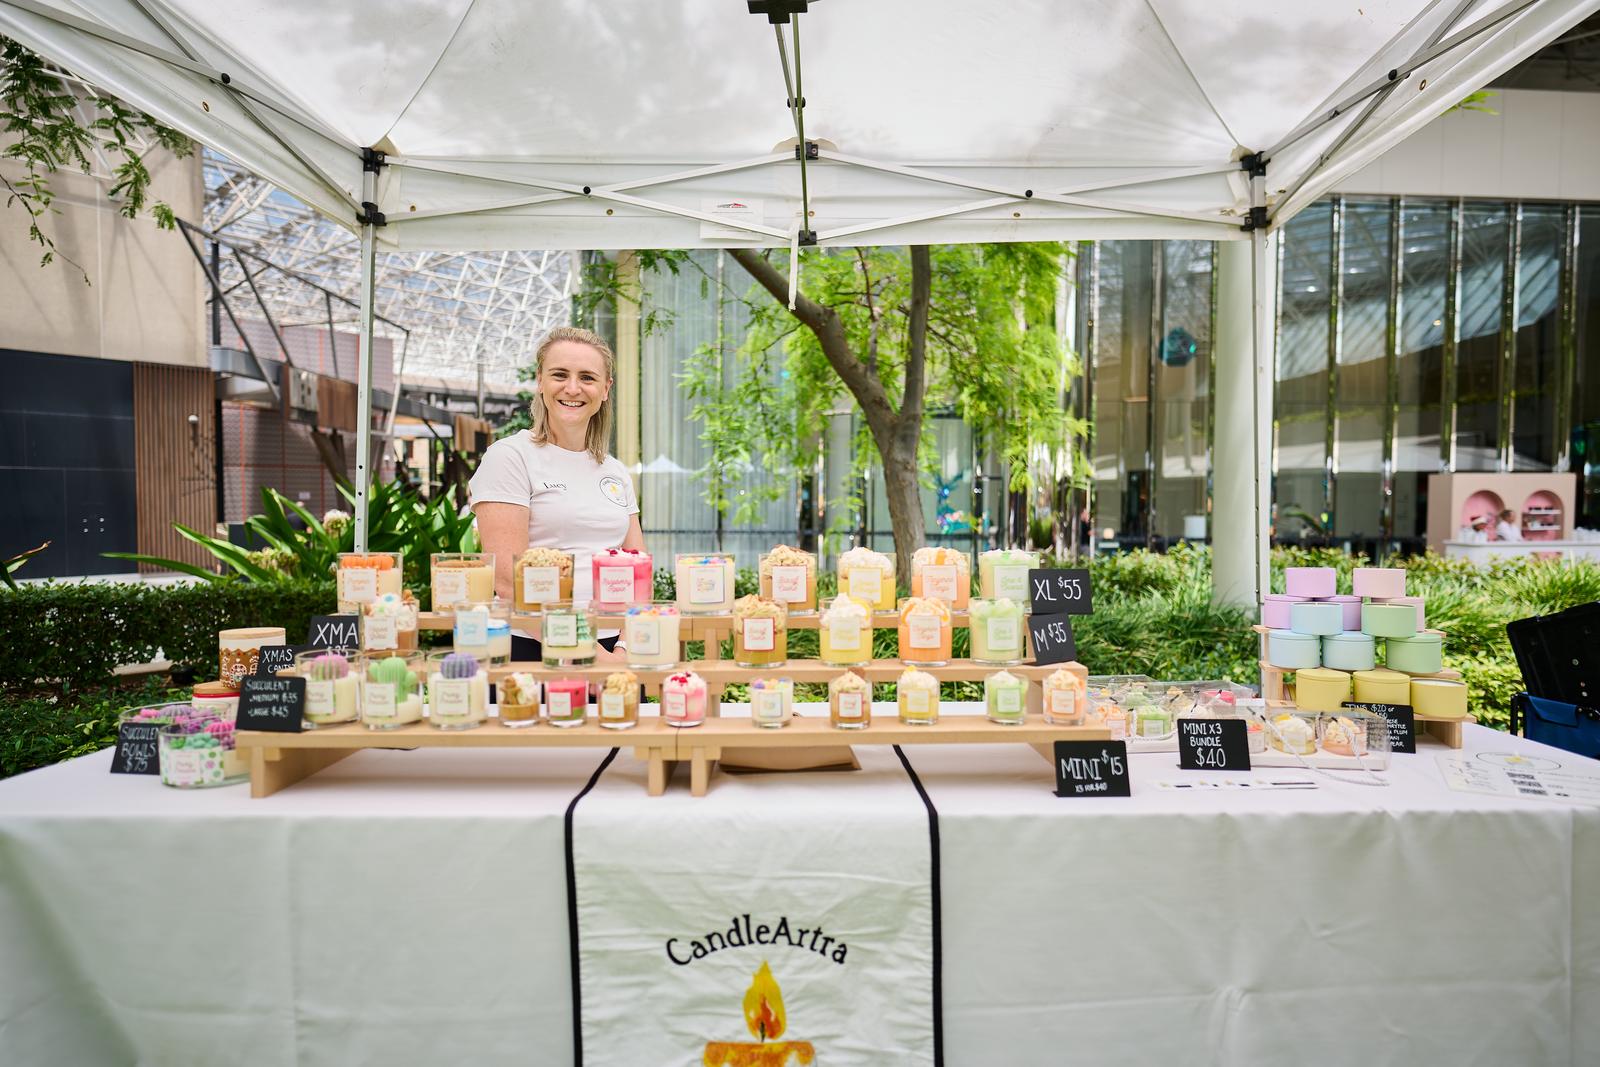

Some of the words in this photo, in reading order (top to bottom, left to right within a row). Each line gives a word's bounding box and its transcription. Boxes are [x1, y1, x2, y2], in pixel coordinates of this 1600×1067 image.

[543, 482, 567, 491] Lucy
[1034, 579, 1057, 601] XL
[1058, 576, 1082, 600] $55
[1033, 628, 1050, 652] M
[1048, 622, 1067, 643] $35
[262, 648, 293, 663] XMAS
[245, 679, 291, 691] SUCCULENT
[1371, 704, 1387, 712] $20
[1183, 723, 1206, 735] MINI
[1190, 737, 1222, 747] BUNDLE
[121, 743, 156, 758] BOWLS
[1195, 747, 1226, 767] $40
[123, 757, 148, 772] $75
[1061, 757, 1103, 781] MINI
[1101, 749, 1124, 776] $15
[666, 914, 849, 966] CandleArtra
